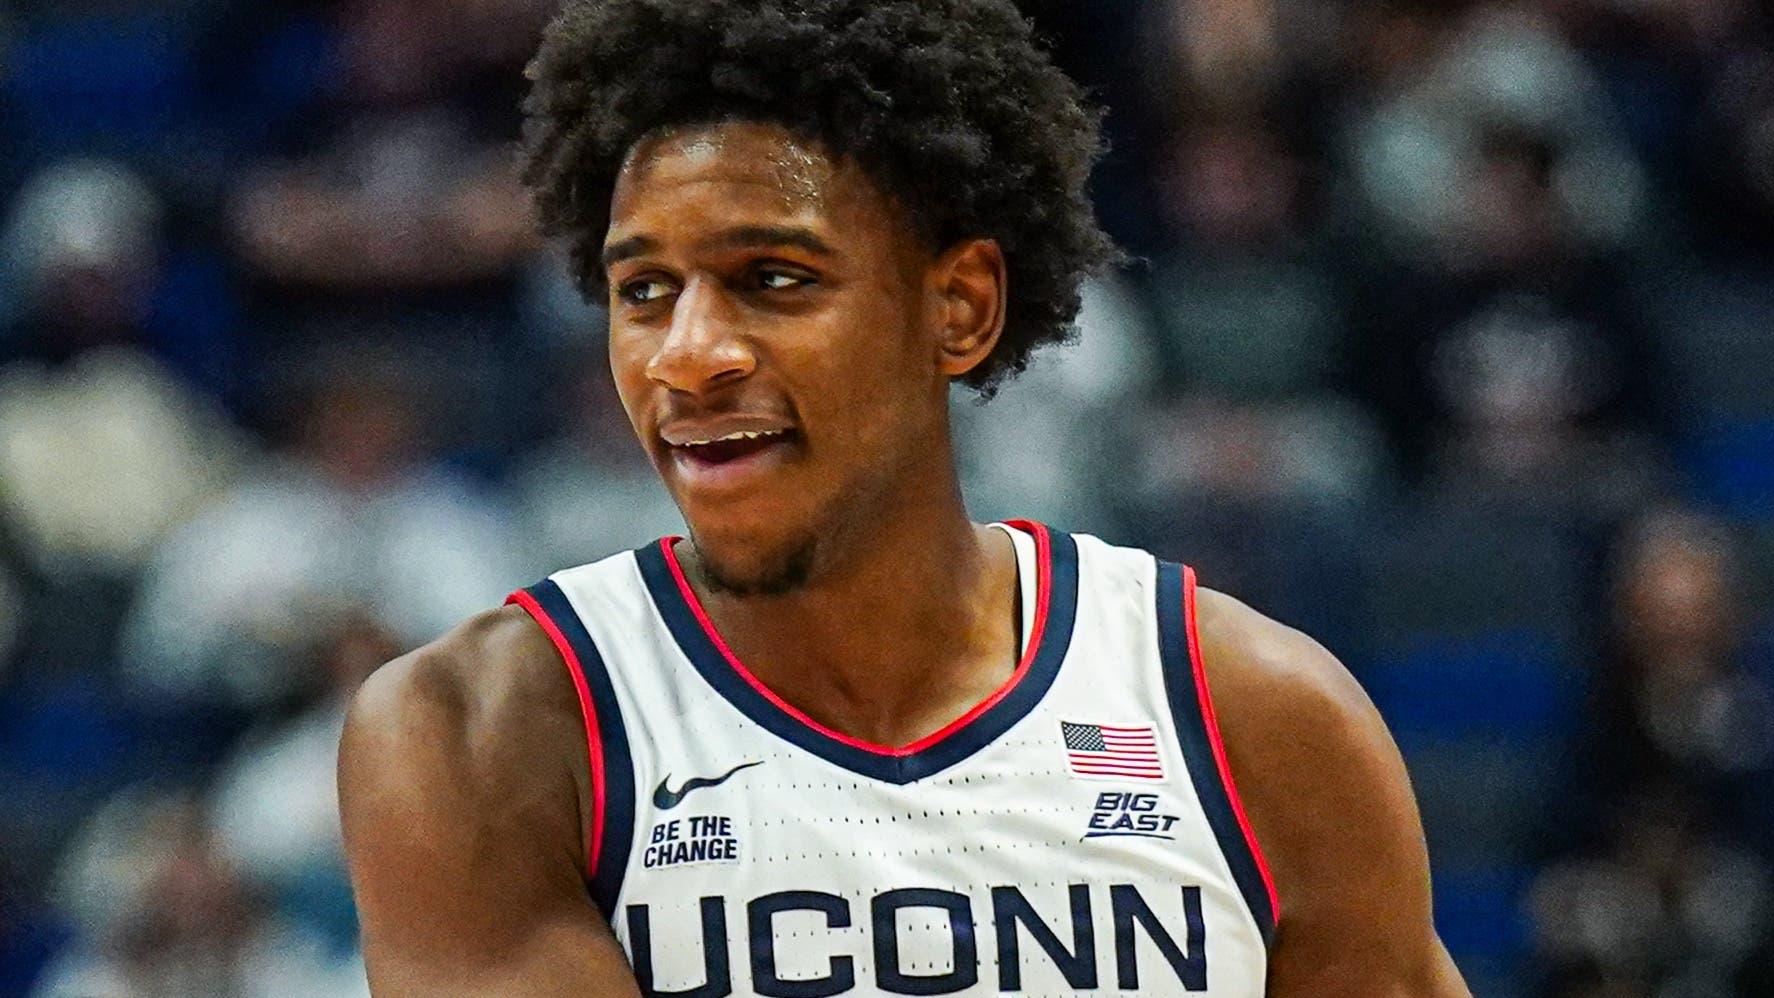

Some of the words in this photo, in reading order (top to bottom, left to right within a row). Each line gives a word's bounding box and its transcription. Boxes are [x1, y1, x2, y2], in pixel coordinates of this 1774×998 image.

[1095, 792, 1159, 811] BIG
[652, 819, 681, 844] BE
[688, 816, 732, 837] THE
[1088, 813, 1180, 831] EAST
[644, 838, 738, 868] CHANGE
